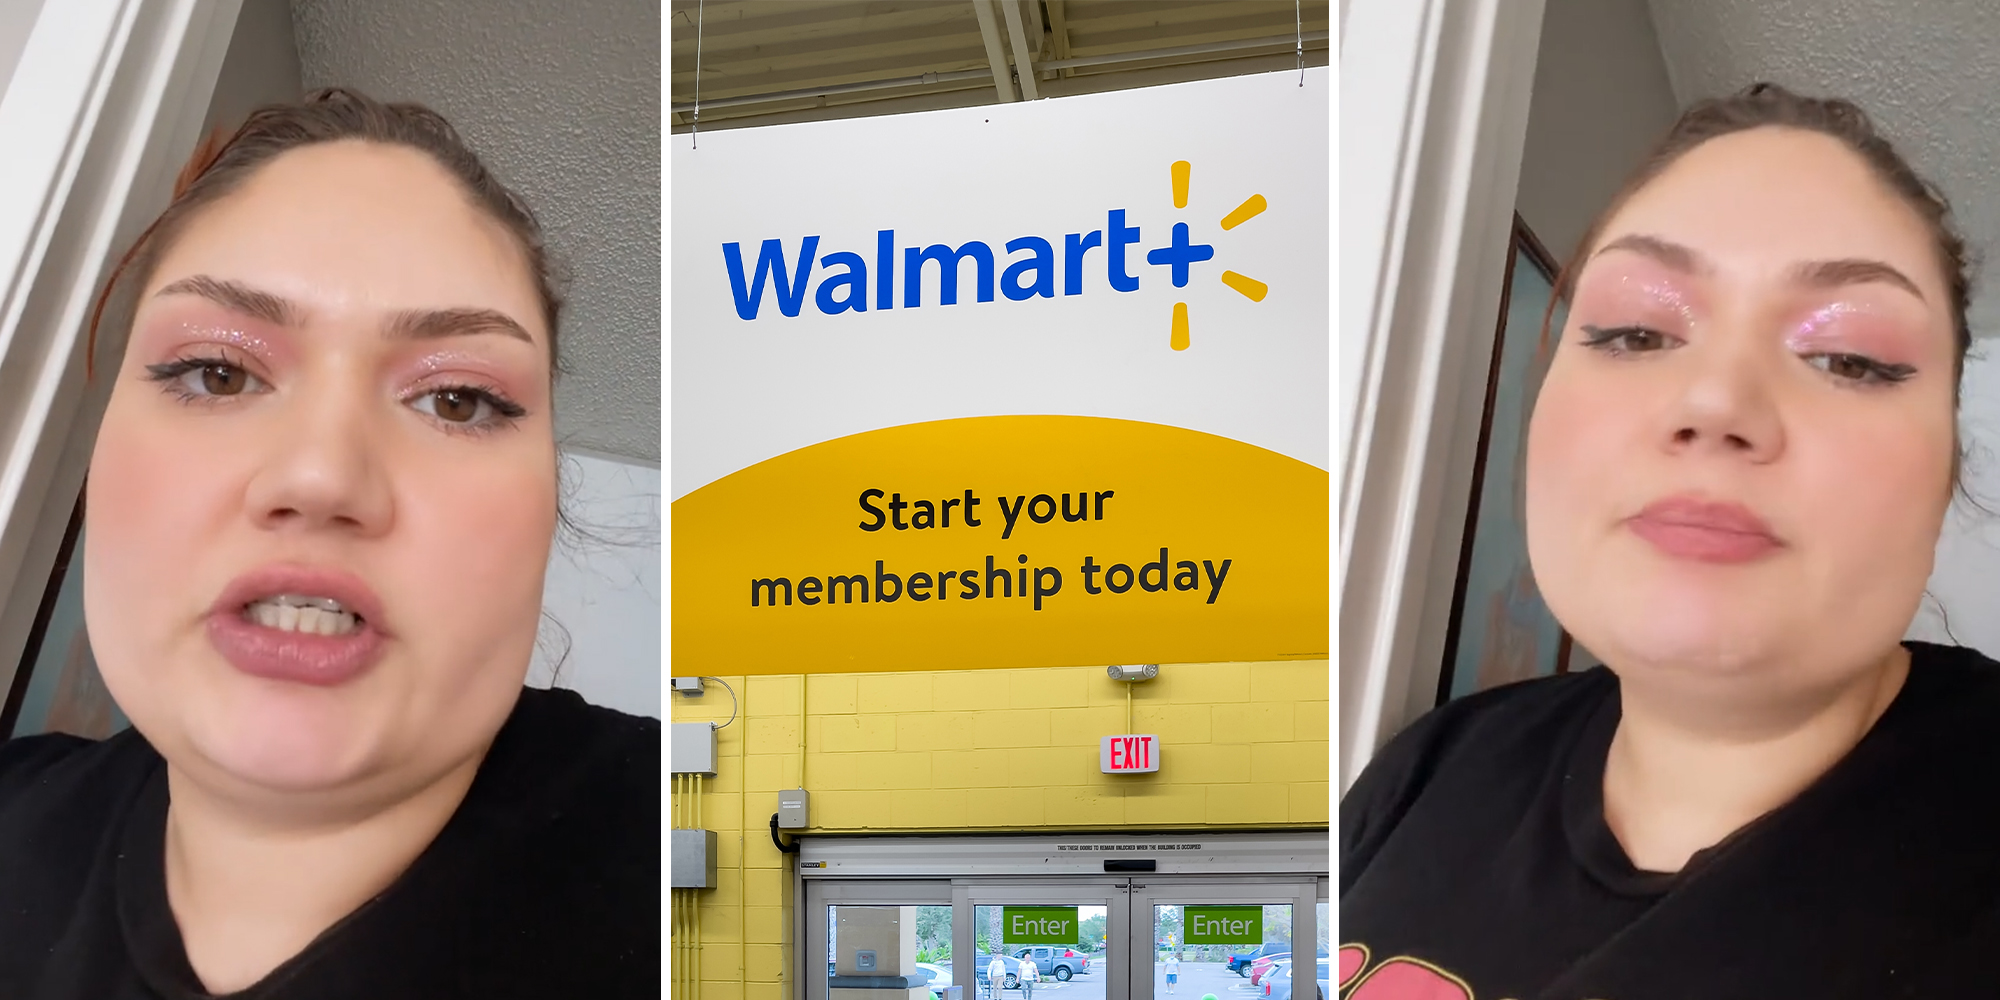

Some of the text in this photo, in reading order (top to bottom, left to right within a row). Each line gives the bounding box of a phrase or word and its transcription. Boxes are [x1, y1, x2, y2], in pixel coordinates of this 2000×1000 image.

[858, 488, 1115, 540] Start your
[751, 547, 1233, 611] membership today
[1110, 737, 1152, 769] EXIT
[1012, 915, 1070, 935] Enter
[1193, 915, 1253, 935] Enter
